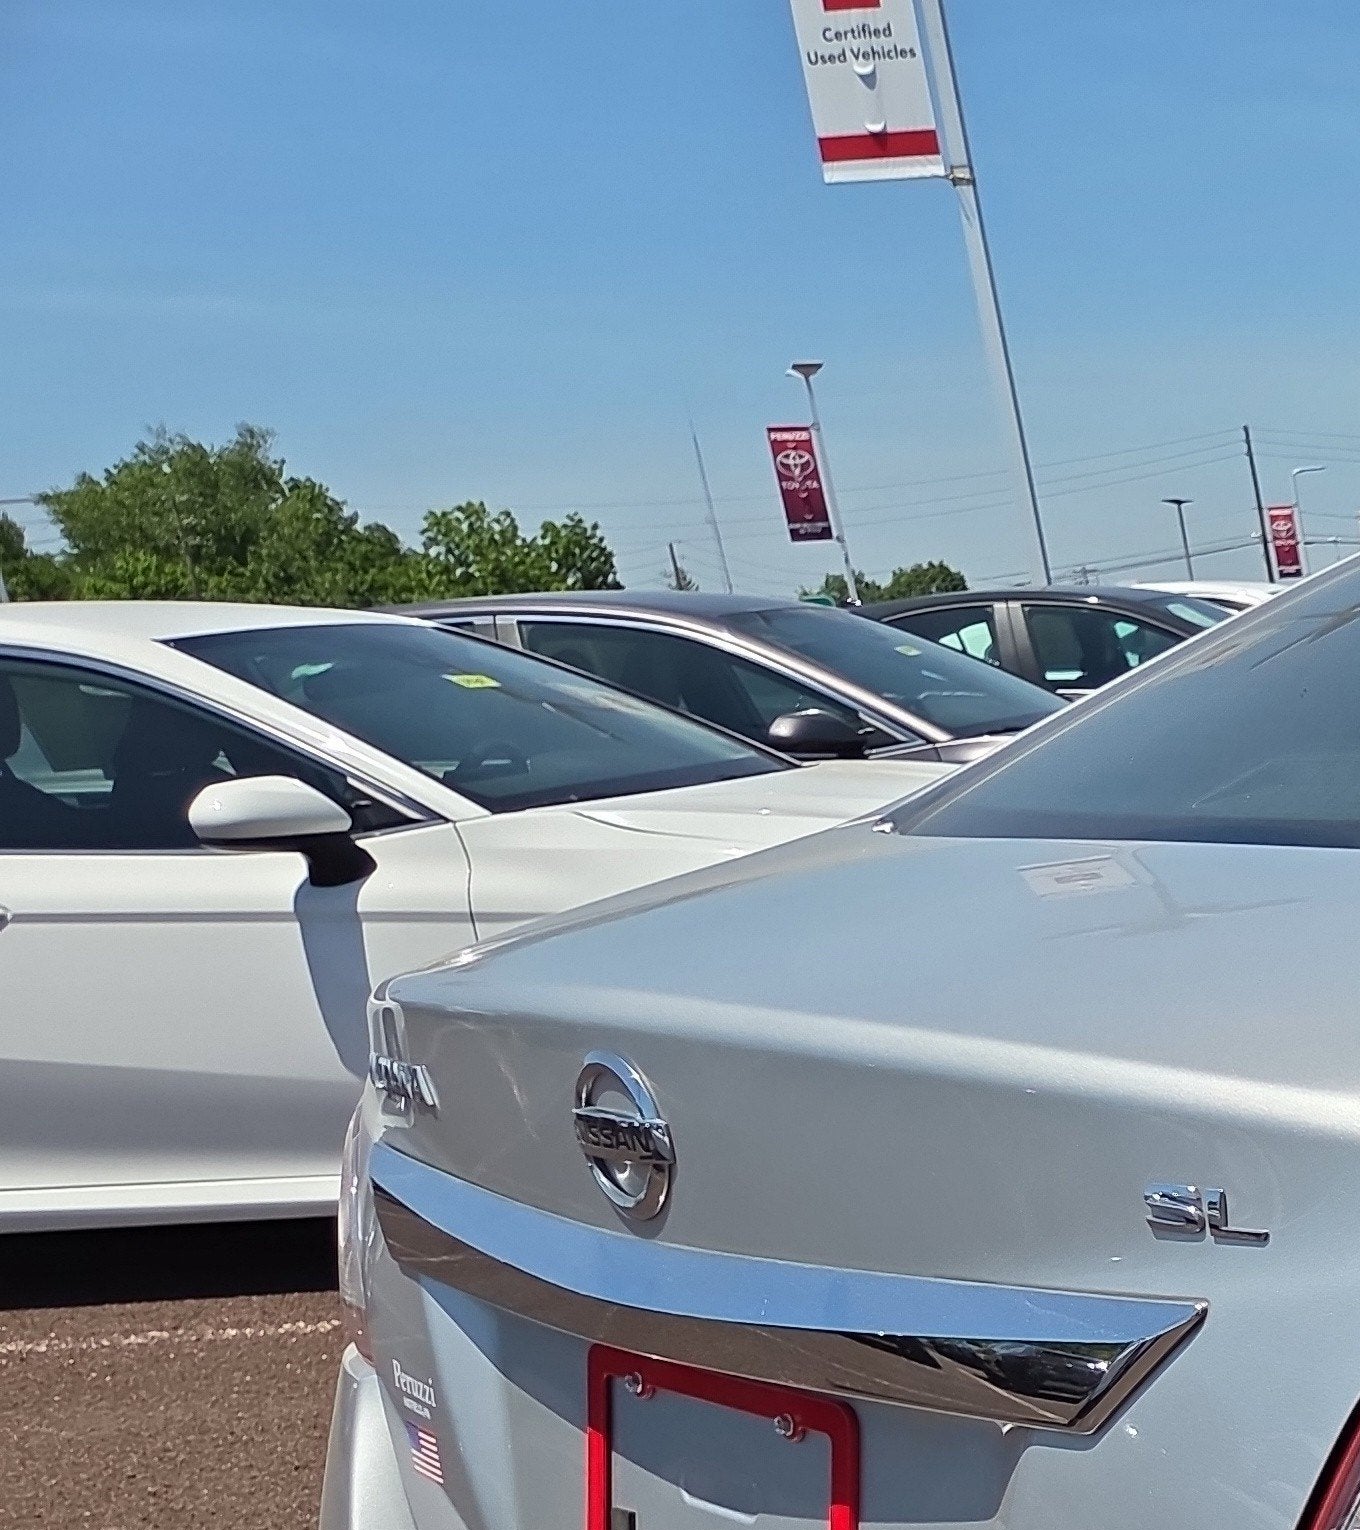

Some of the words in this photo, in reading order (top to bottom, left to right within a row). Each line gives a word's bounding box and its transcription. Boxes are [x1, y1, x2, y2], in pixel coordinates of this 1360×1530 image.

[822, 22, 893, 42] Certified
[807, 48, 846, 66] Used
[850, 44, 917, 61] Vehicles
[577, 1118, 654, 1160] SSAN
[1144, 1183, 1269, 1241] SL
[391, 1358, 437, 1408] Peruzzi
